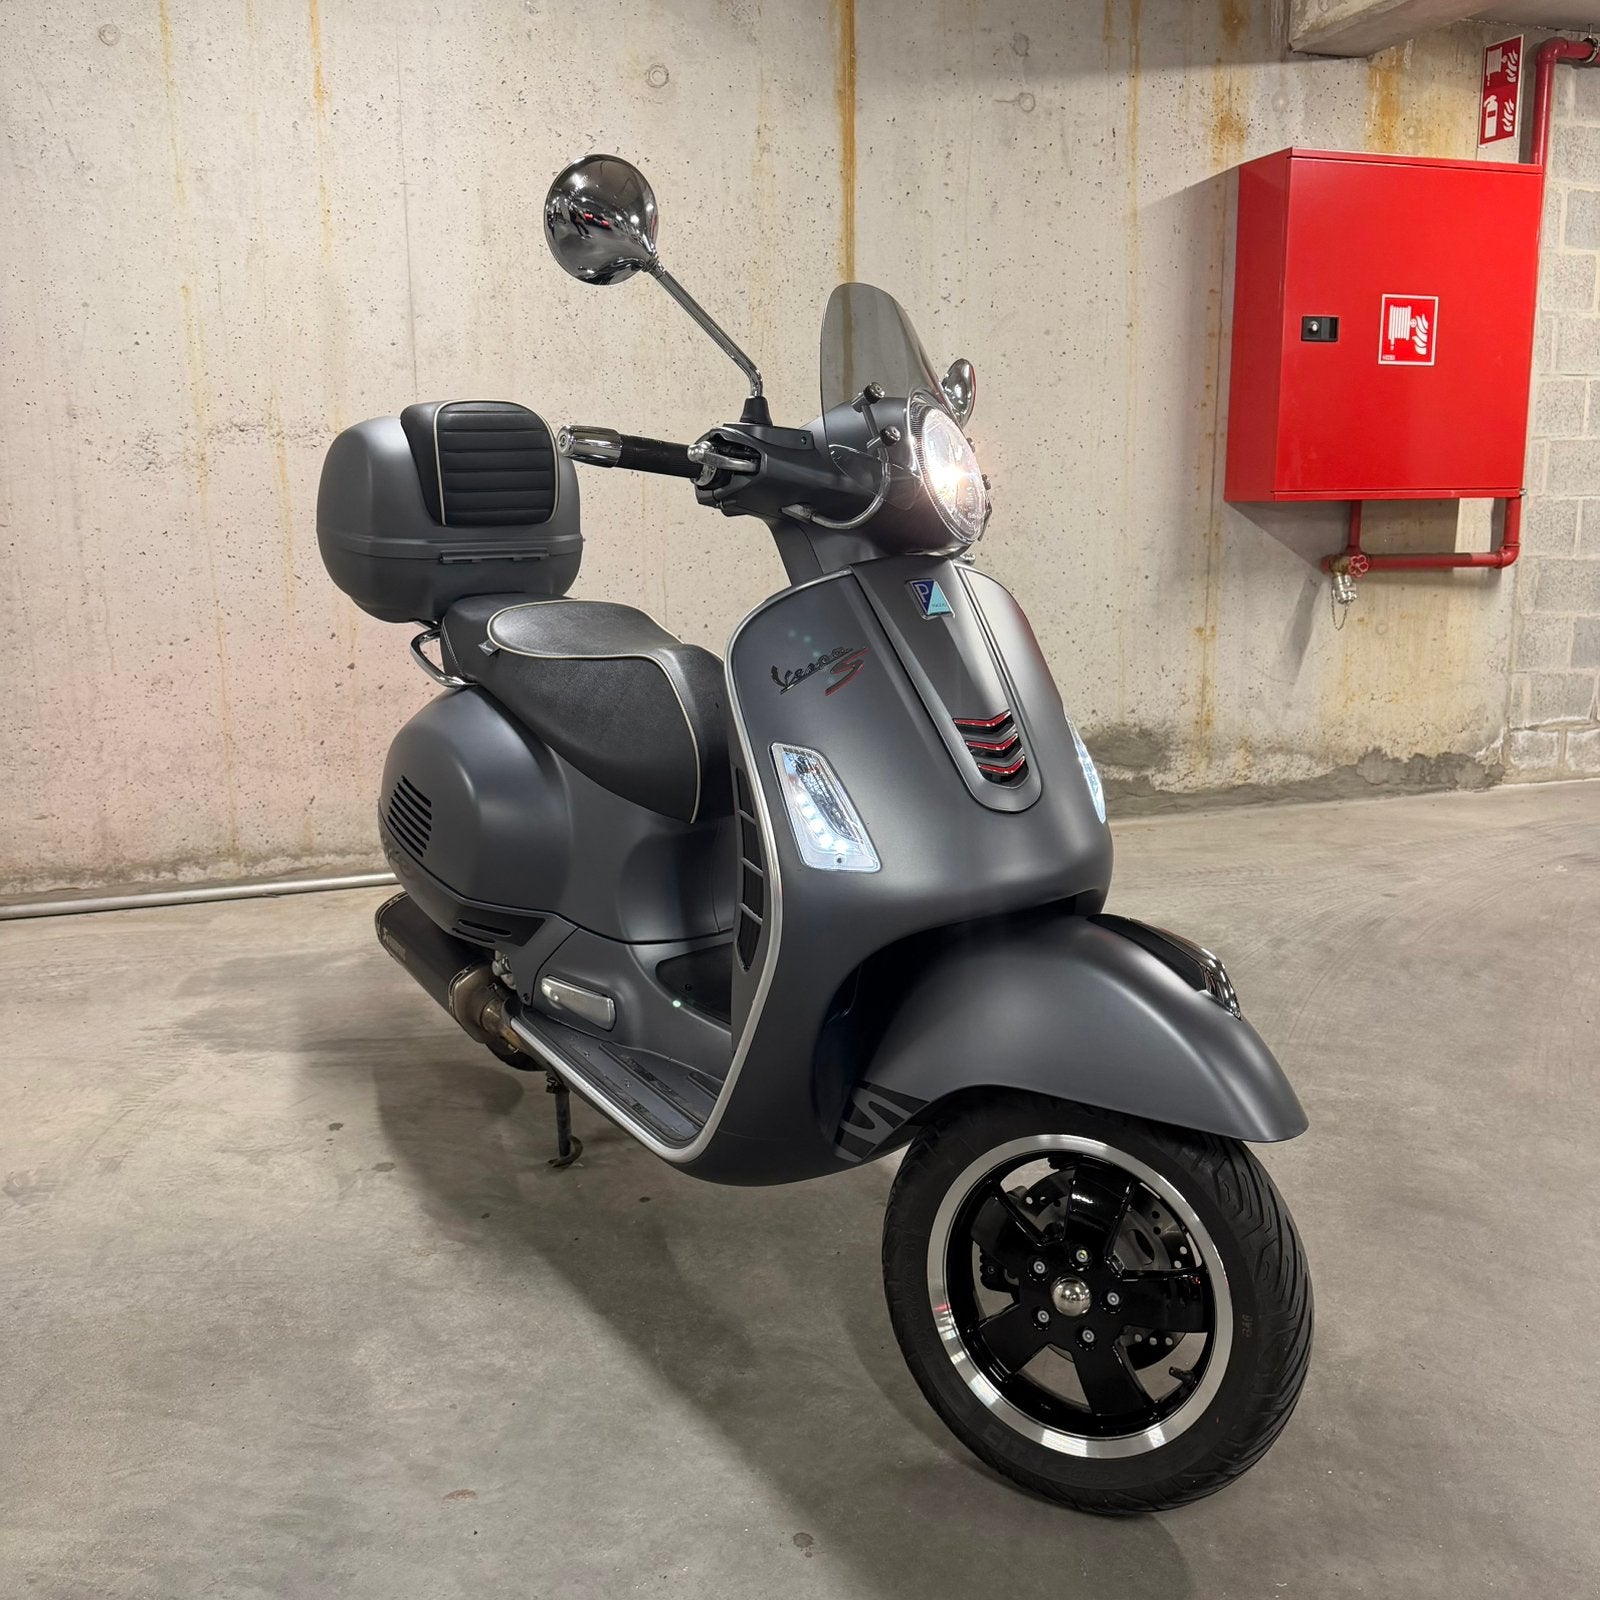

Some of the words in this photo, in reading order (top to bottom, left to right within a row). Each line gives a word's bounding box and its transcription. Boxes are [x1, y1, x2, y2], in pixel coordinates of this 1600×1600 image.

[914, 583, 930, 603] P
[770, 645, 854, 695] Vespa
[824, 646, 871, 696] S
